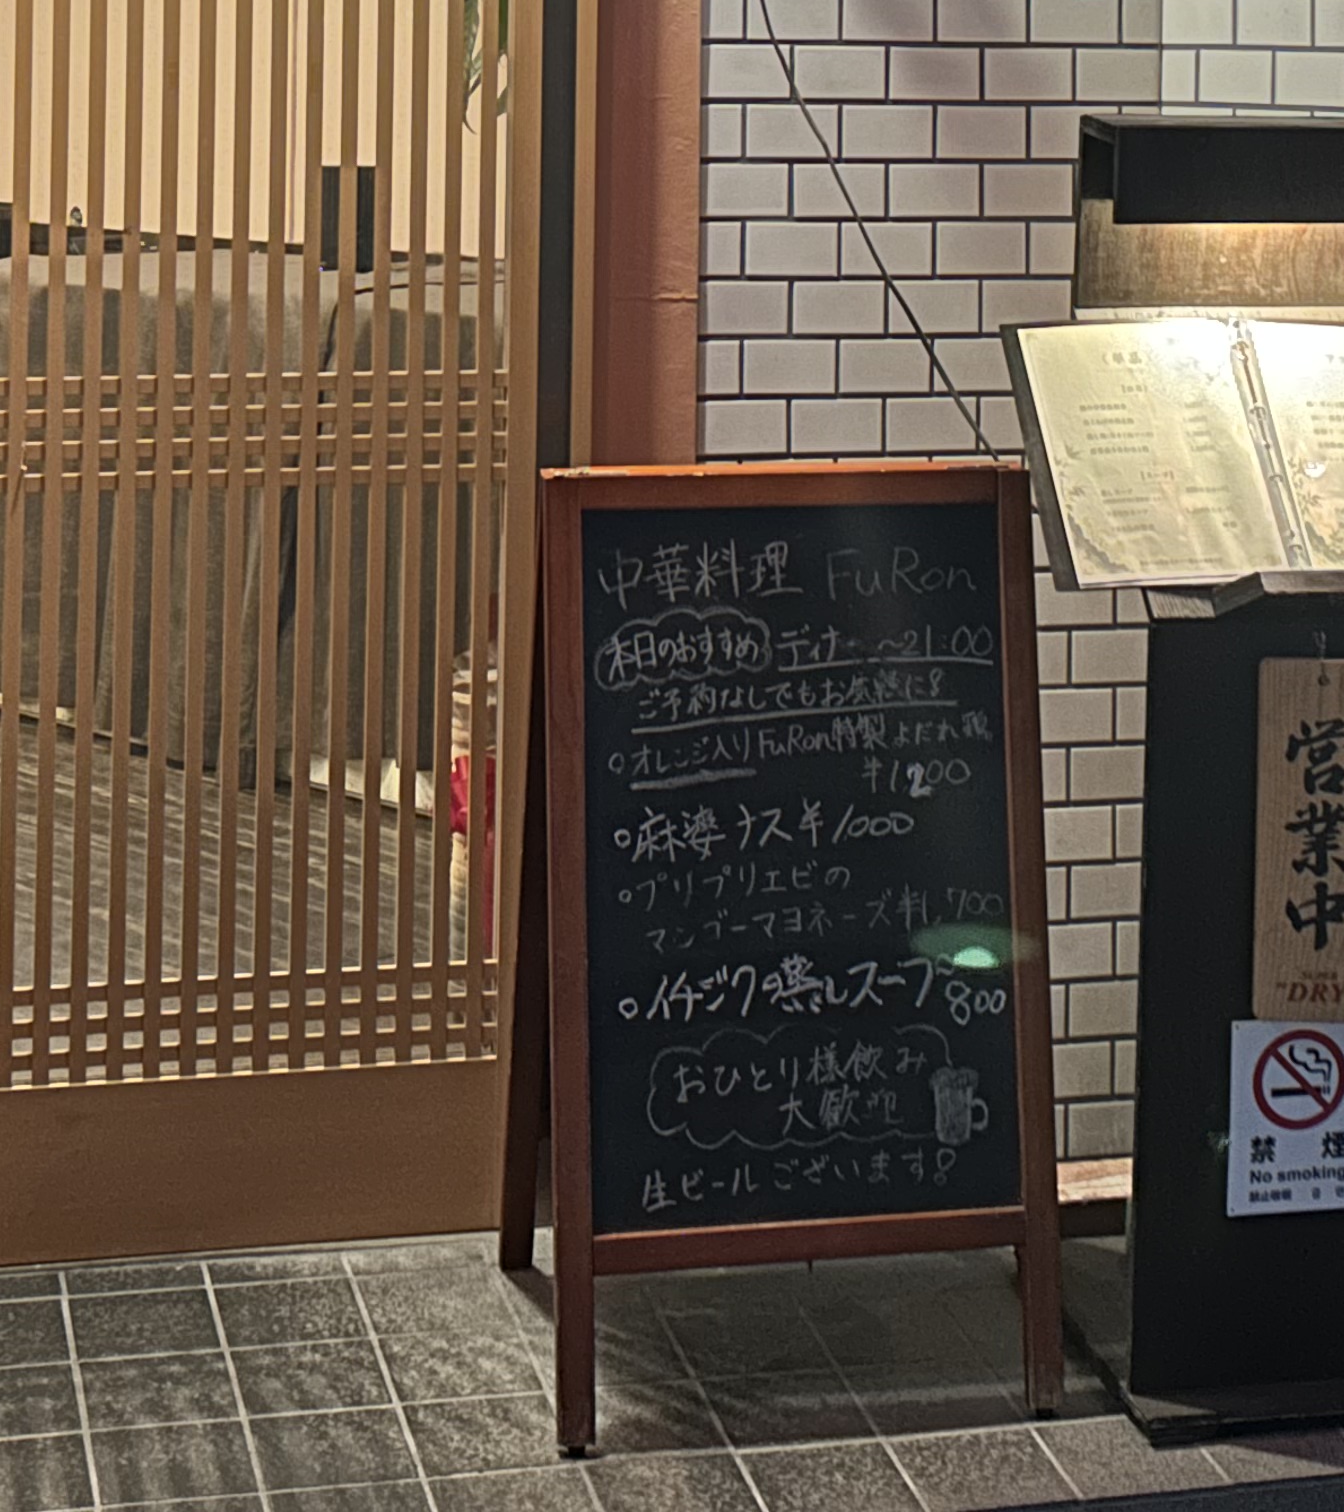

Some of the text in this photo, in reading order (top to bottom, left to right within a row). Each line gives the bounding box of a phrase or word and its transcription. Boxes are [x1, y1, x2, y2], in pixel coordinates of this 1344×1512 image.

[598, 539, 804, 610] 中華料理
[1249, 1170, 1273, 1185] No
